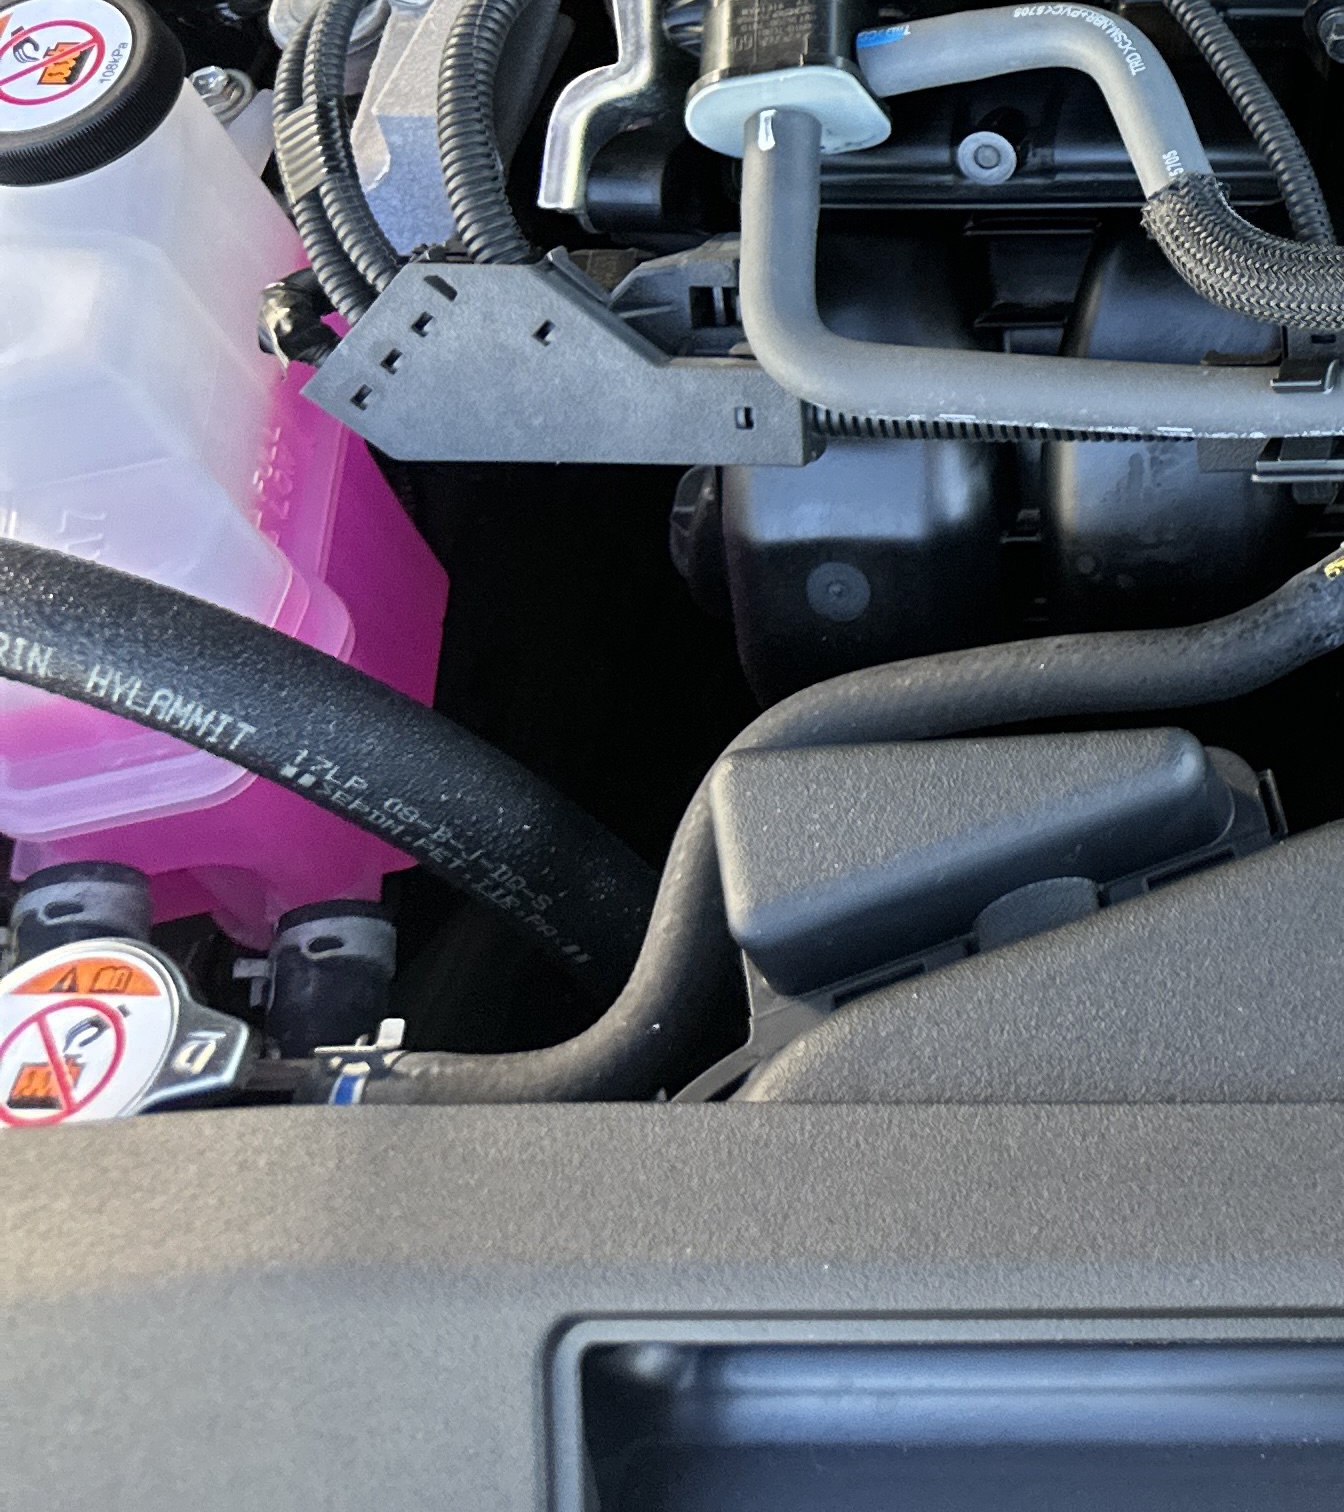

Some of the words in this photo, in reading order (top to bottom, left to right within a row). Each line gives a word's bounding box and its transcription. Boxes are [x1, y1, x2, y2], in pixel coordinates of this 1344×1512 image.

[100, 41, 129, 84] 108kPa
[1124, 50, 1146, 77] TRD
[85, 662, 257, 751] HYLAMMIT
